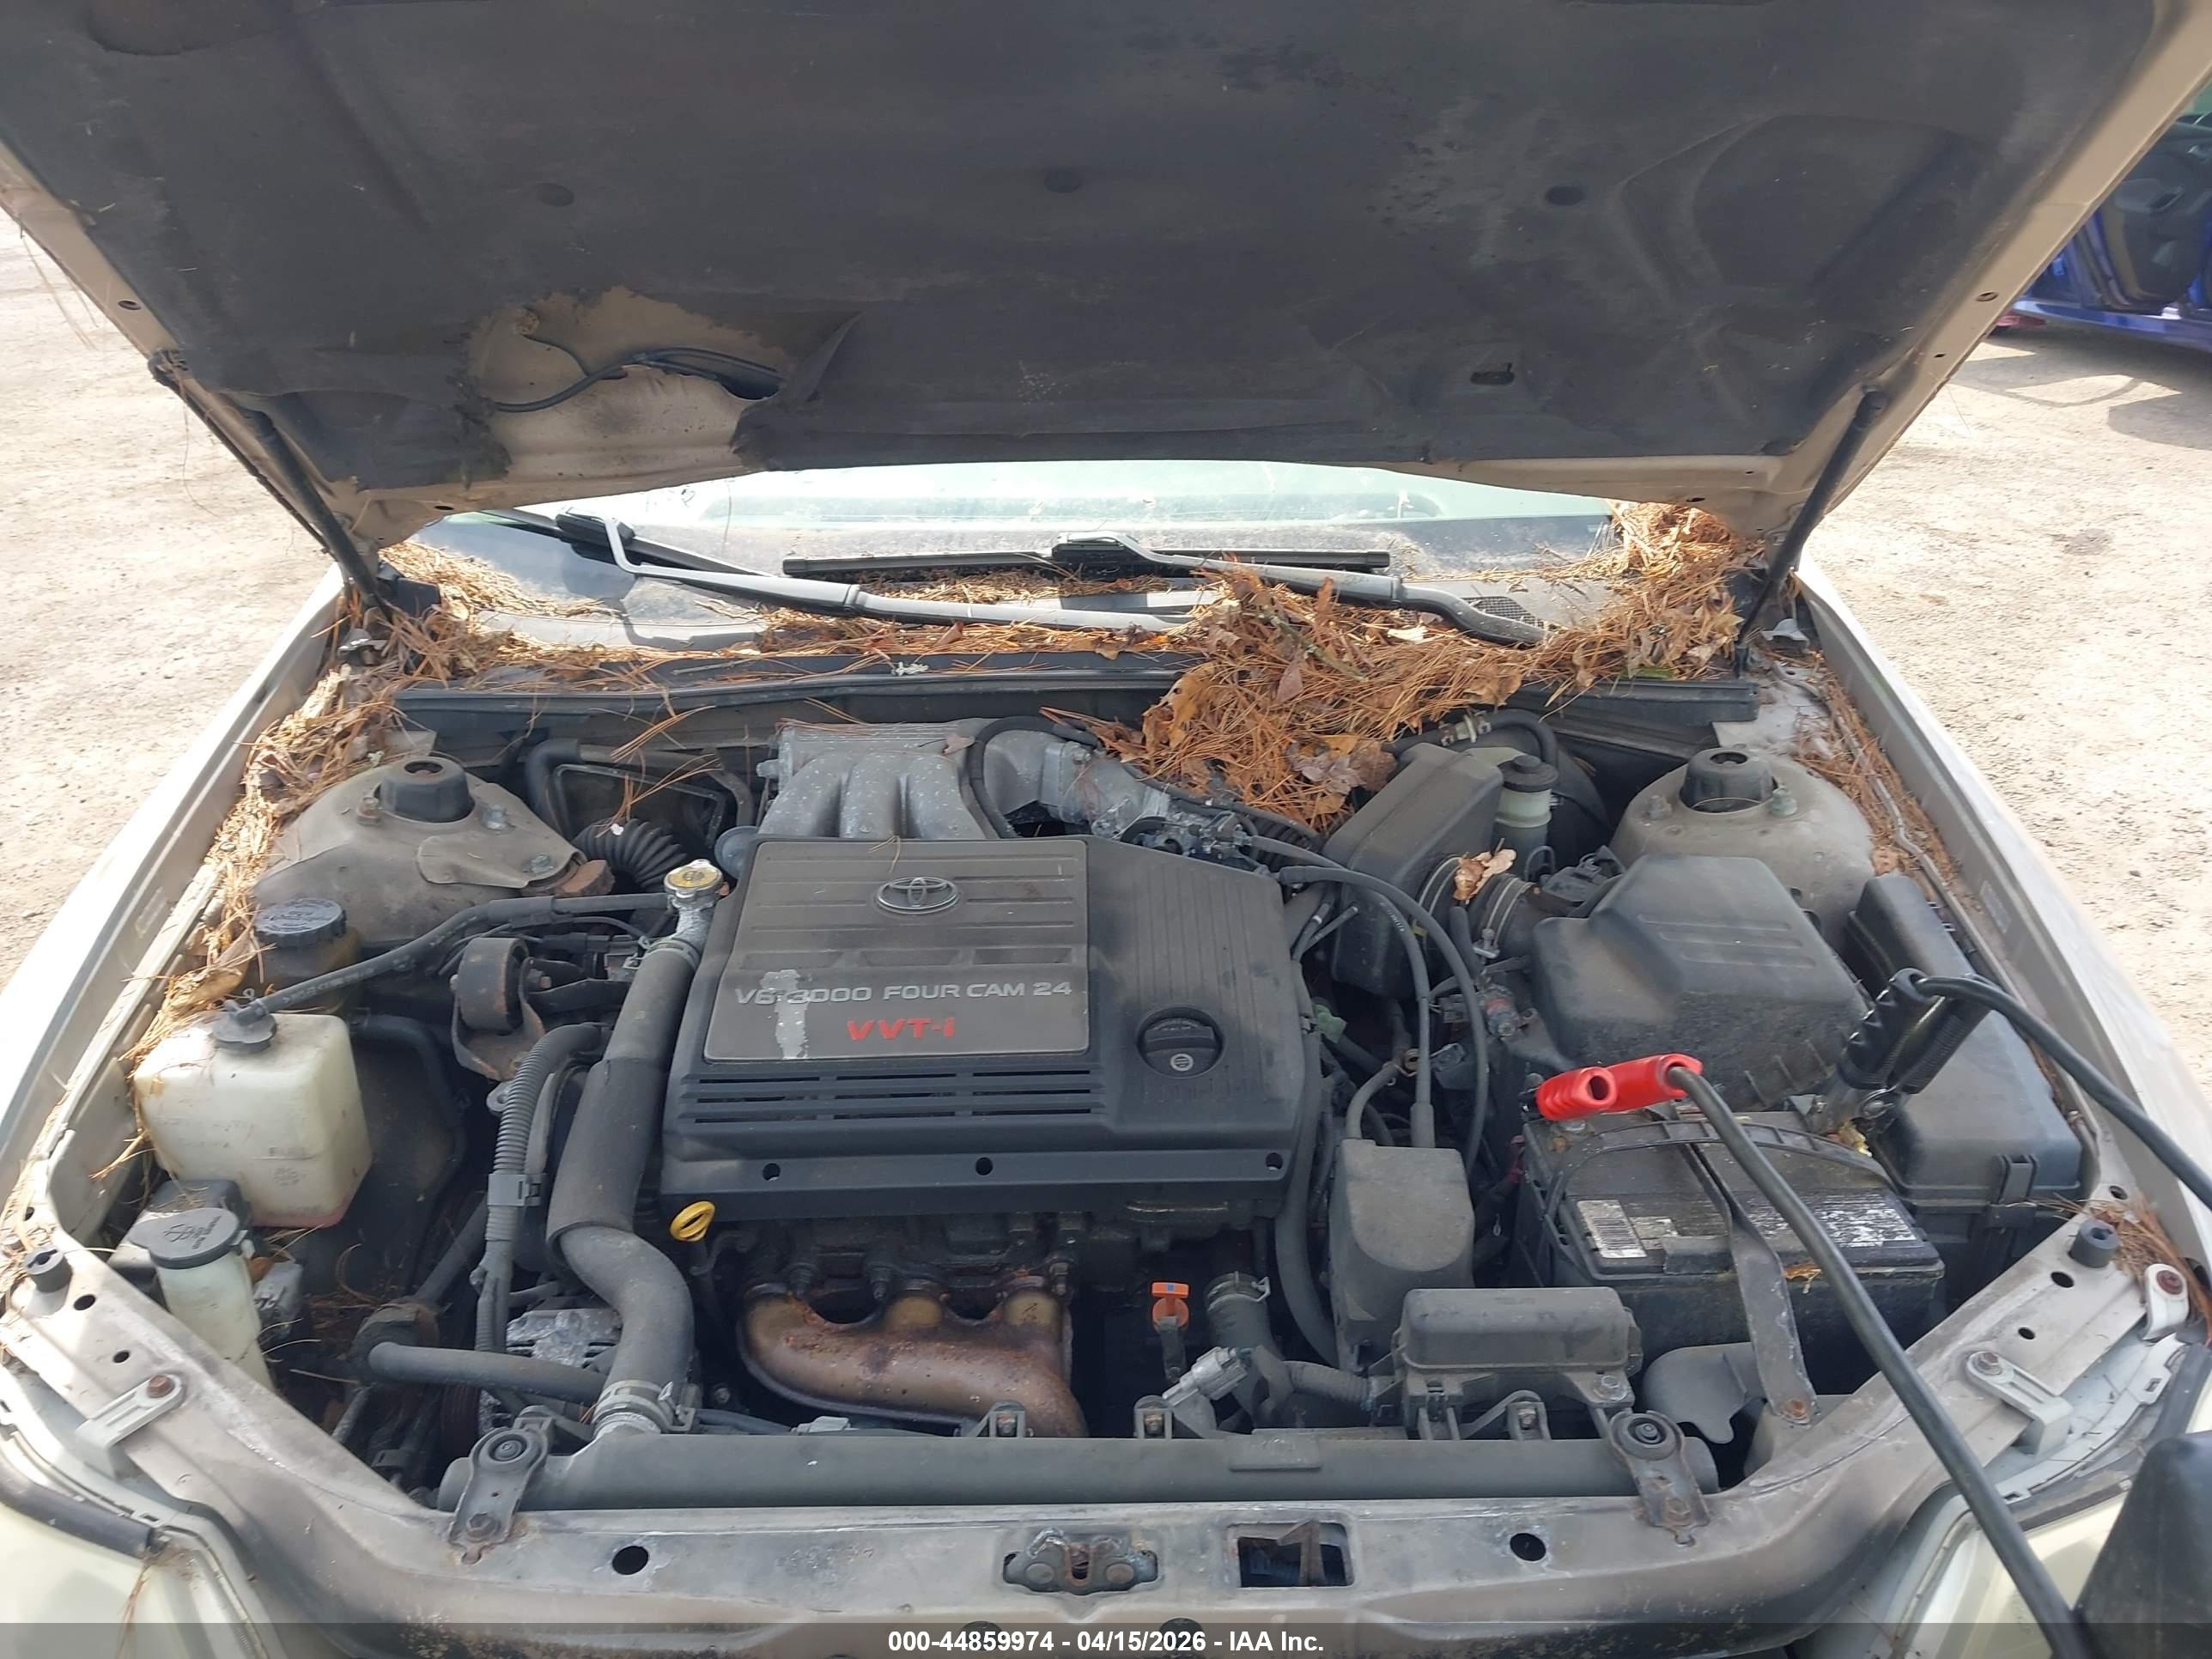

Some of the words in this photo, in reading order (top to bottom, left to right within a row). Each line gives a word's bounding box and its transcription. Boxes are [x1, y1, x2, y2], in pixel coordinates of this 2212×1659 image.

[883, 984, 960, 1000] FOUR
[966, 982, 1026, 999] CAM
[1032, 981, 1073, 996] 24
[847, 1017, 956, 1041] VVT-i
